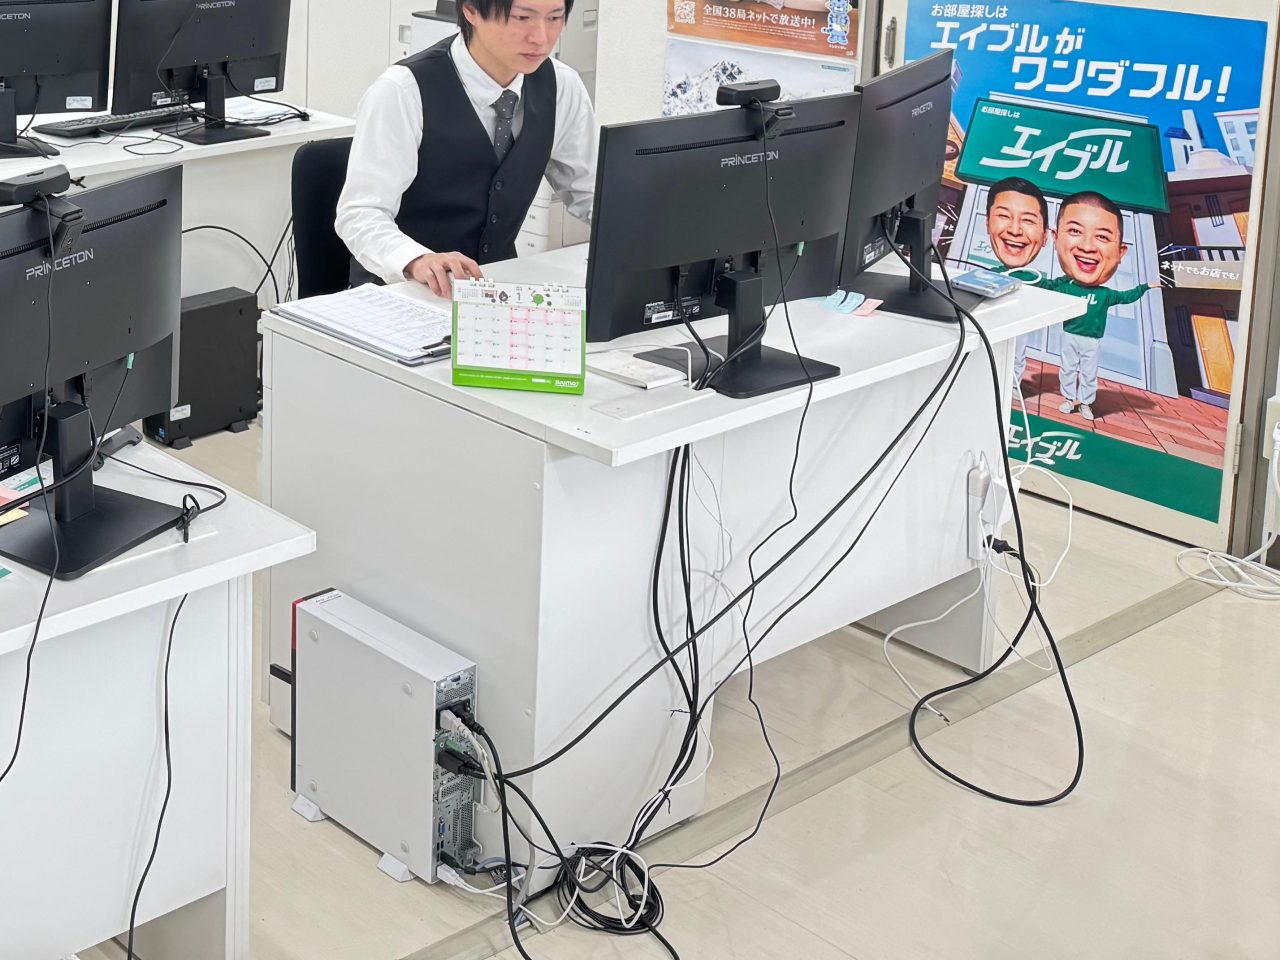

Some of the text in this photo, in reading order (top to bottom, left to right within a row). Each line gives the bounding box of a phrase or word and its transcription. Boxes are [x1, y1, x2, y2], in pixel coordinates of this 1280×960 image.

[703, 2, 817, 29] 全国38局ネットで放送中!
[930, 3, 1009, 19] お部屋探しは
[930, 20, 1086, 55] エイブルが
[1011, 56, 1233, 103] ワンダフル!
[980, 106, 1021, 119] お部屋探しは
[978, 125, 1132, 180] エイブル
[1160, 260, 1240, 281] ネットでもお店でも!
